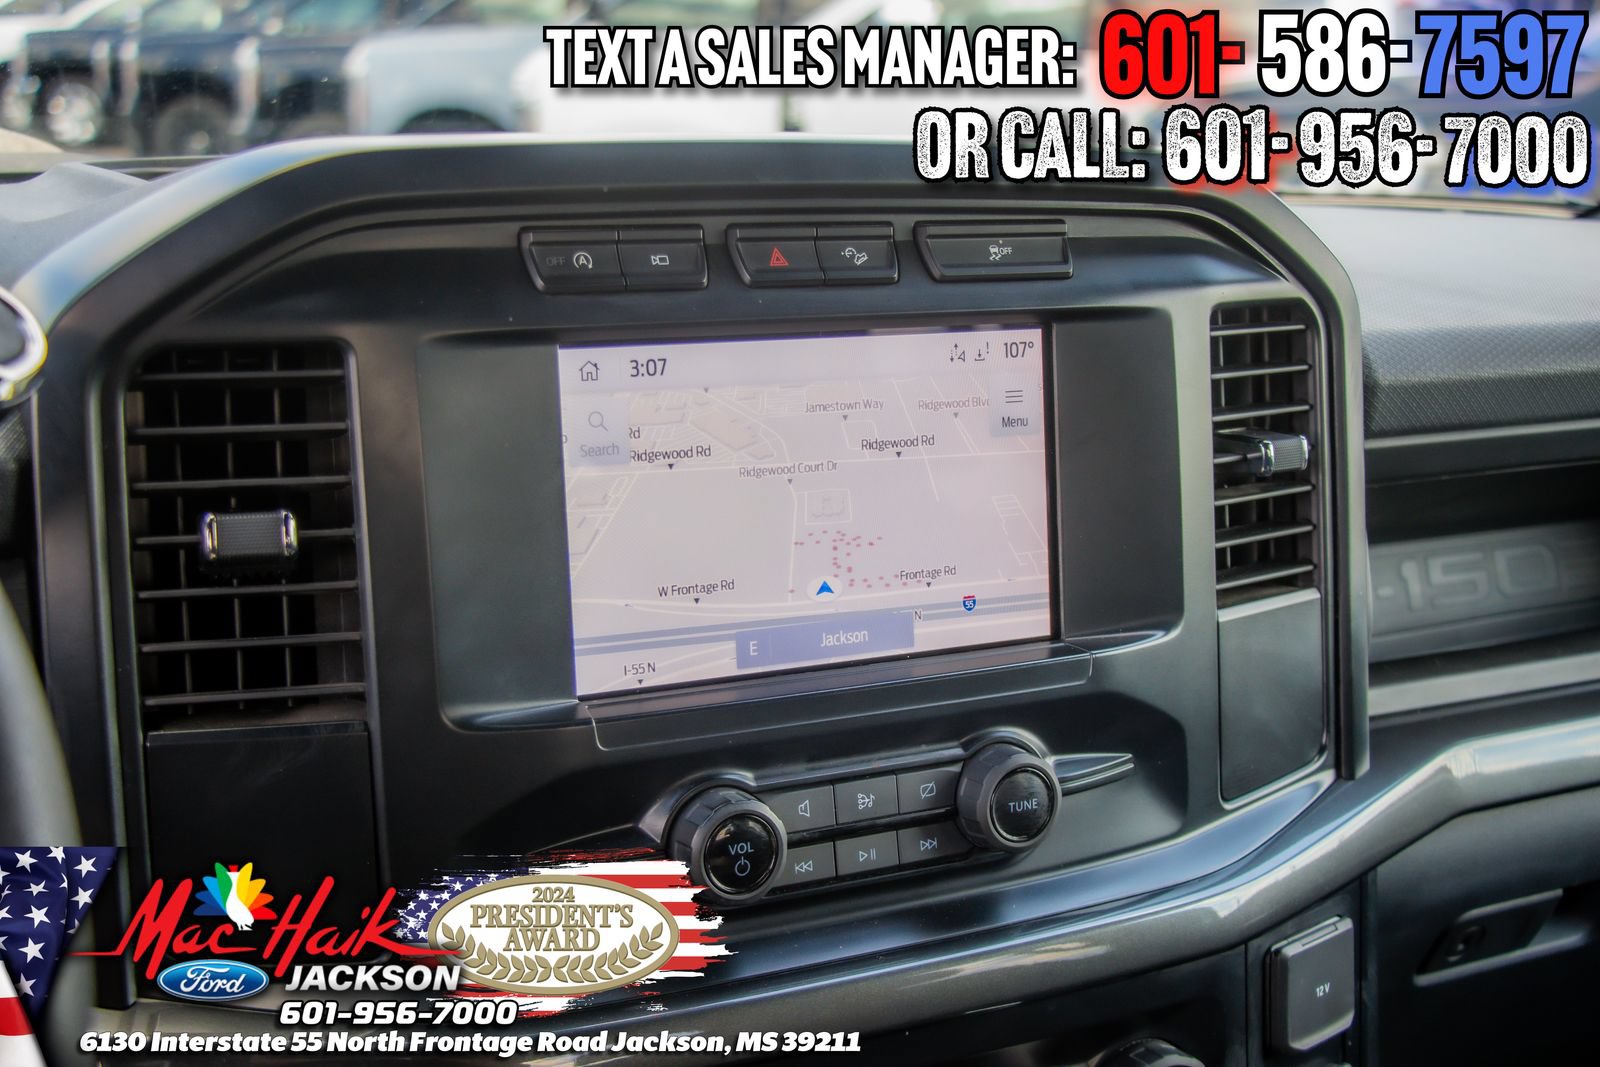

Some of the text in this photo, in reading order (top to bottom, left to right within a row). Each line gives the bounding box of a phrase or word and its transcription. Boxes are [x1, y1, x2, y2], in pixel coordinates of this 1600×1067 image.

[999, 247, 1012, 256] OFF
[630, 358, 667, 377] 3:07
[804, 398, 884, 414] Jamestown Way
[918, 397, 970, 412] Ridgewood
[1001, 416, 1029, 428] Menu
[580, 443, 620, 458] Search
[861, 434, 935, 453] Ridgewood Rd
[630, 445, 712, 464] Ridgewood Rd
[739, 461, 838, 479] Ridgewood Court Dr
[900, 565, 957, 582] Frontage Rd
[657, 579, 735, 597] W Frontage Rd
[965, 600, 974, 609] 55
[914, 610, 922, 620] N
[820, 628, 869, 647] Jackson
[750, 641, 758, 656] E
[624, 661, 656, 676] I-55 N
[1008, 798, 1039, 813] TUNE
[728, 843, 754, 856] VOL
